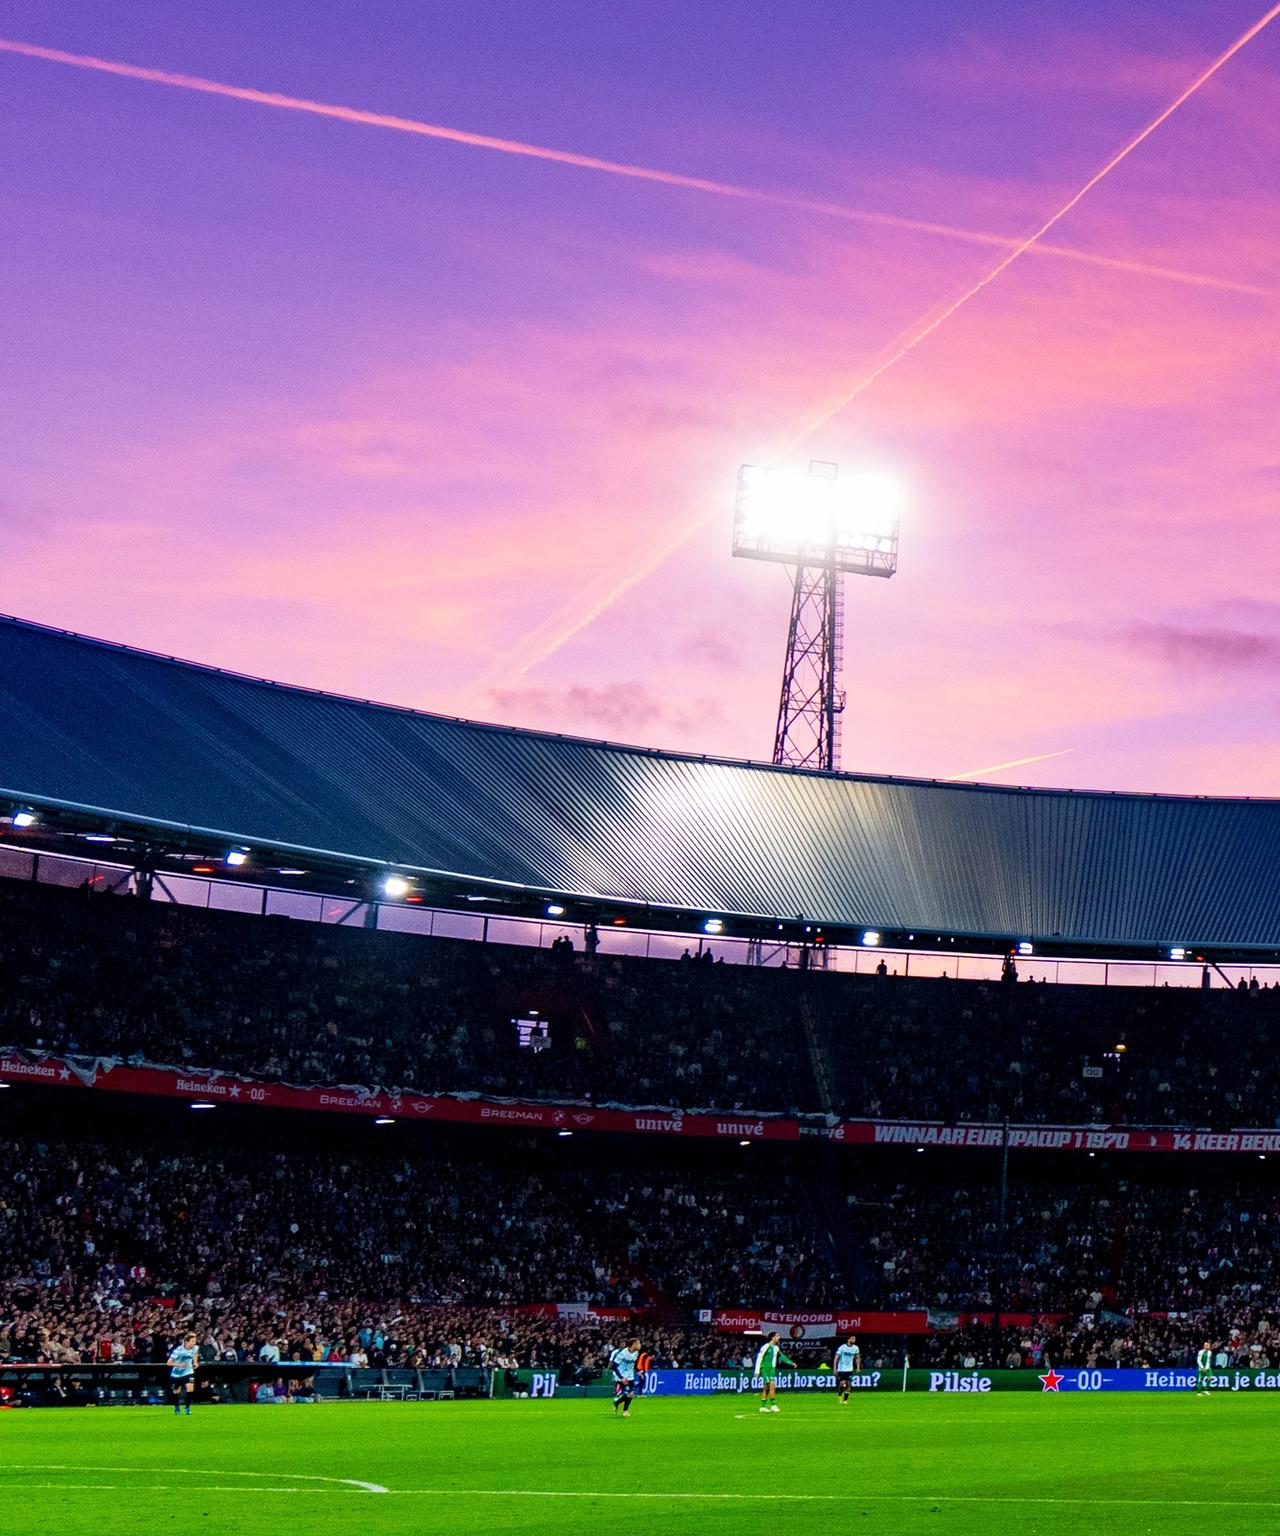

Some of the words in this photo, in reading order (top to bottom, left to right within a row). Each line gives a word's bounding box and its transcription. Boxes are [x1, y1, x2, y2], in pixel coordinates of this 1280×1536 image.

[1, 1061, 55, 1077] Heineken
[176, 1079, 226, 1094] Heineken
[319, 1095, 382, 1109] BREEMAN
[480, 1107, 543, 1121] BREEMAN
[716, 1121, 764, 1136] univé
[874, 1125, 964, 1144] WINNAAR
[1085, 1132, 1130, 1149] 1970
[1173, 1134, 1191, 1150] 14
[1194, 1134, 1239, 1150] KEER
[764, 1312, 833, 1322] FEYENOORD
[685, 1373, 737, 1390] Heineken
[737, 1373, 749, 1393] je
[794, 1373, 836, 1388] horen
[850, 1372, 881, 1388] an?
[929, 1372, 992, 1393] Pilsie
[1233, 1372, 1250, 1391] je
